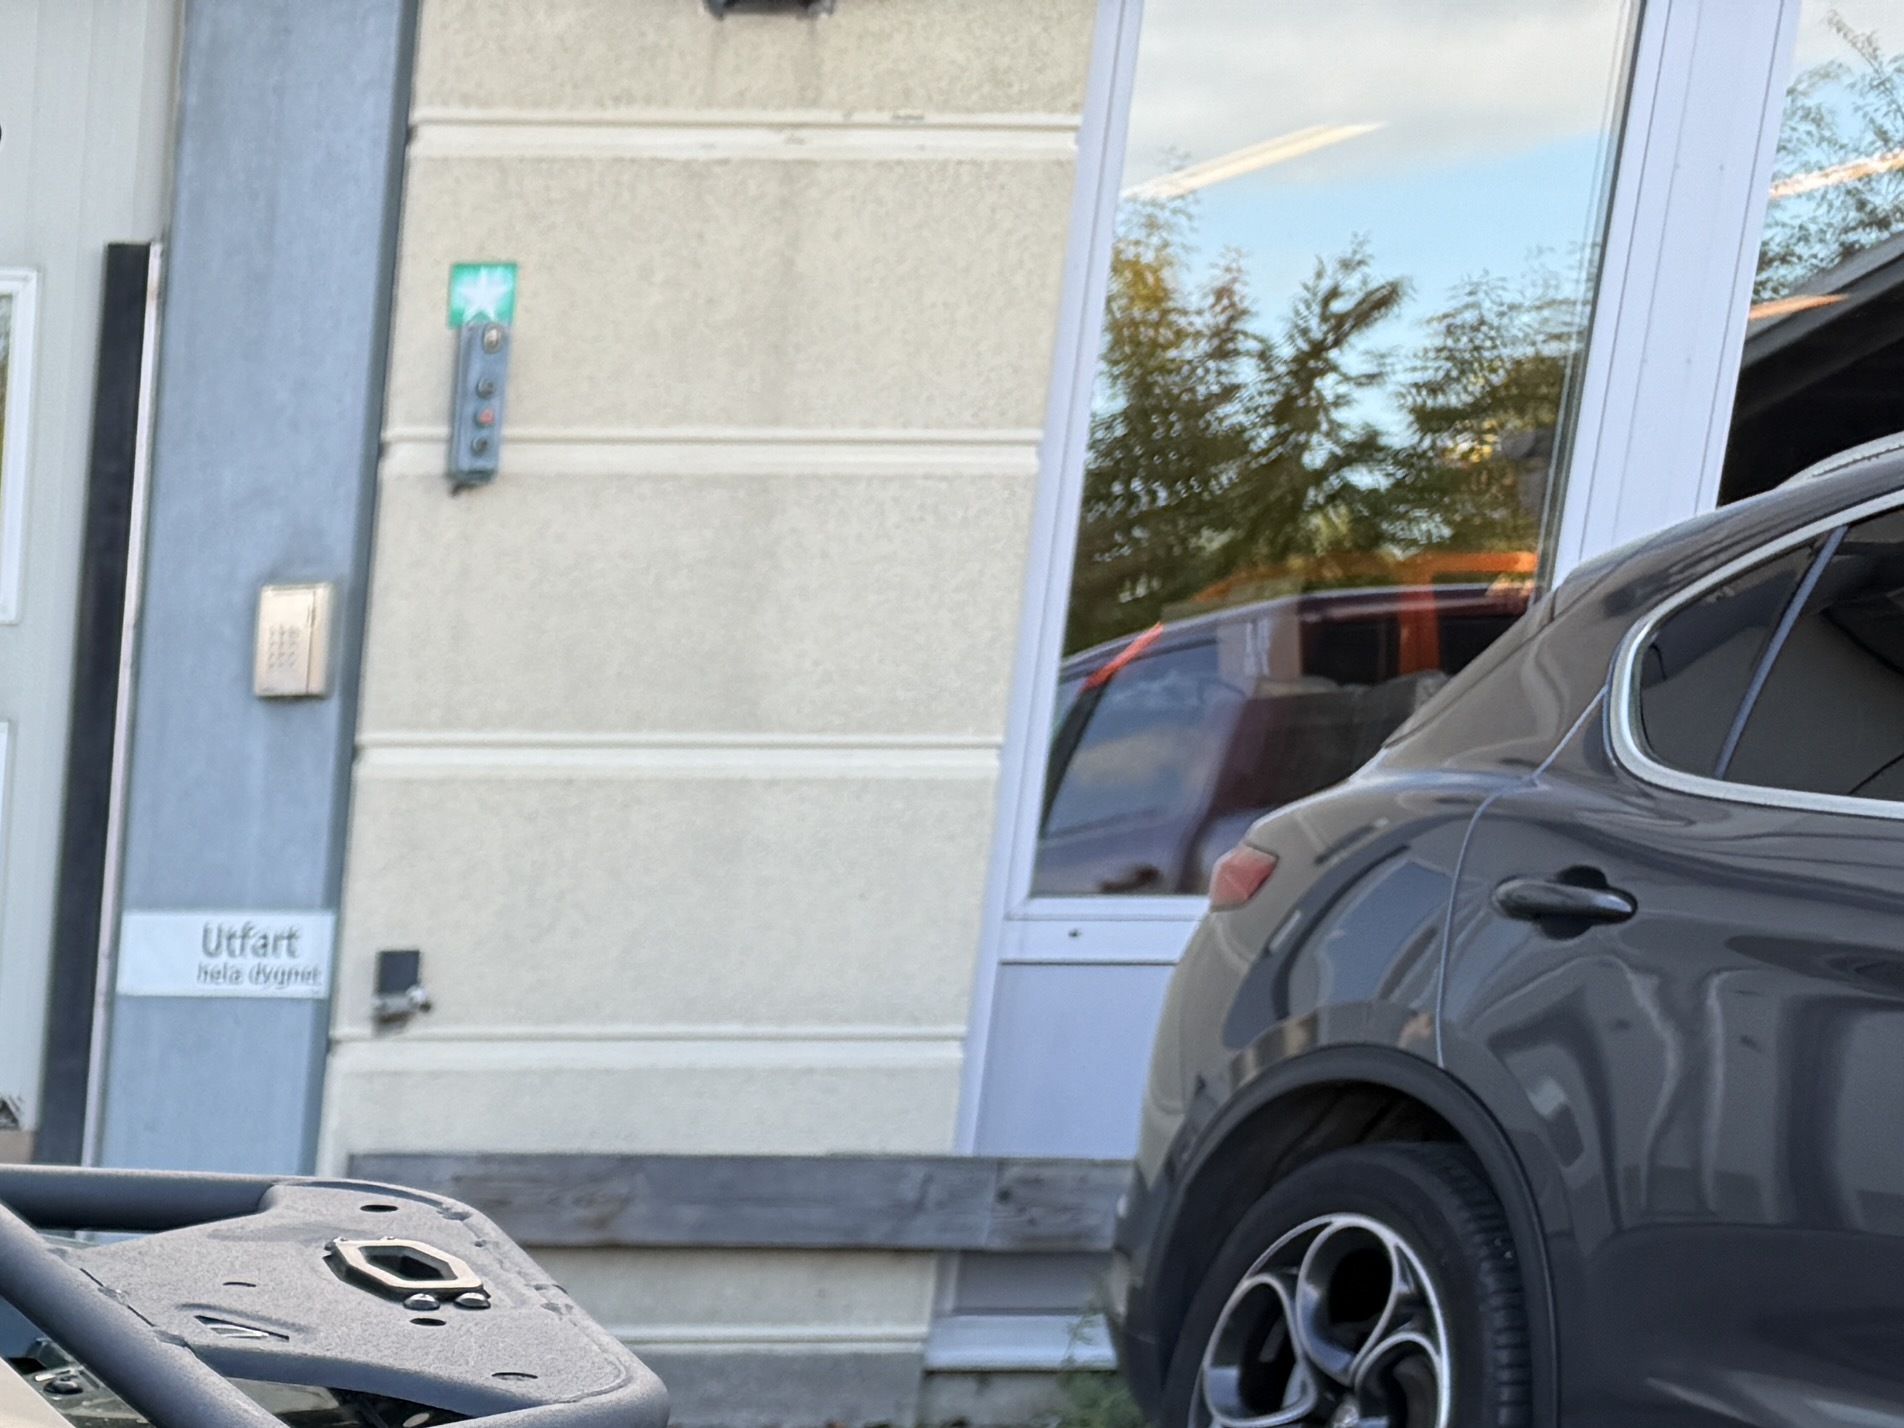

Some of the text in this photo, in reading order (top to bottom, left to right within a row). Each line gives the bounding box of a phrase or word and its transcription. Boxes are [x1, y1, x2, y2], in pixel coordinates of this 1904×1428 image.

[202, 921, 299, 958] Utfart
[197, 962, 321, 989] hela dygnet
